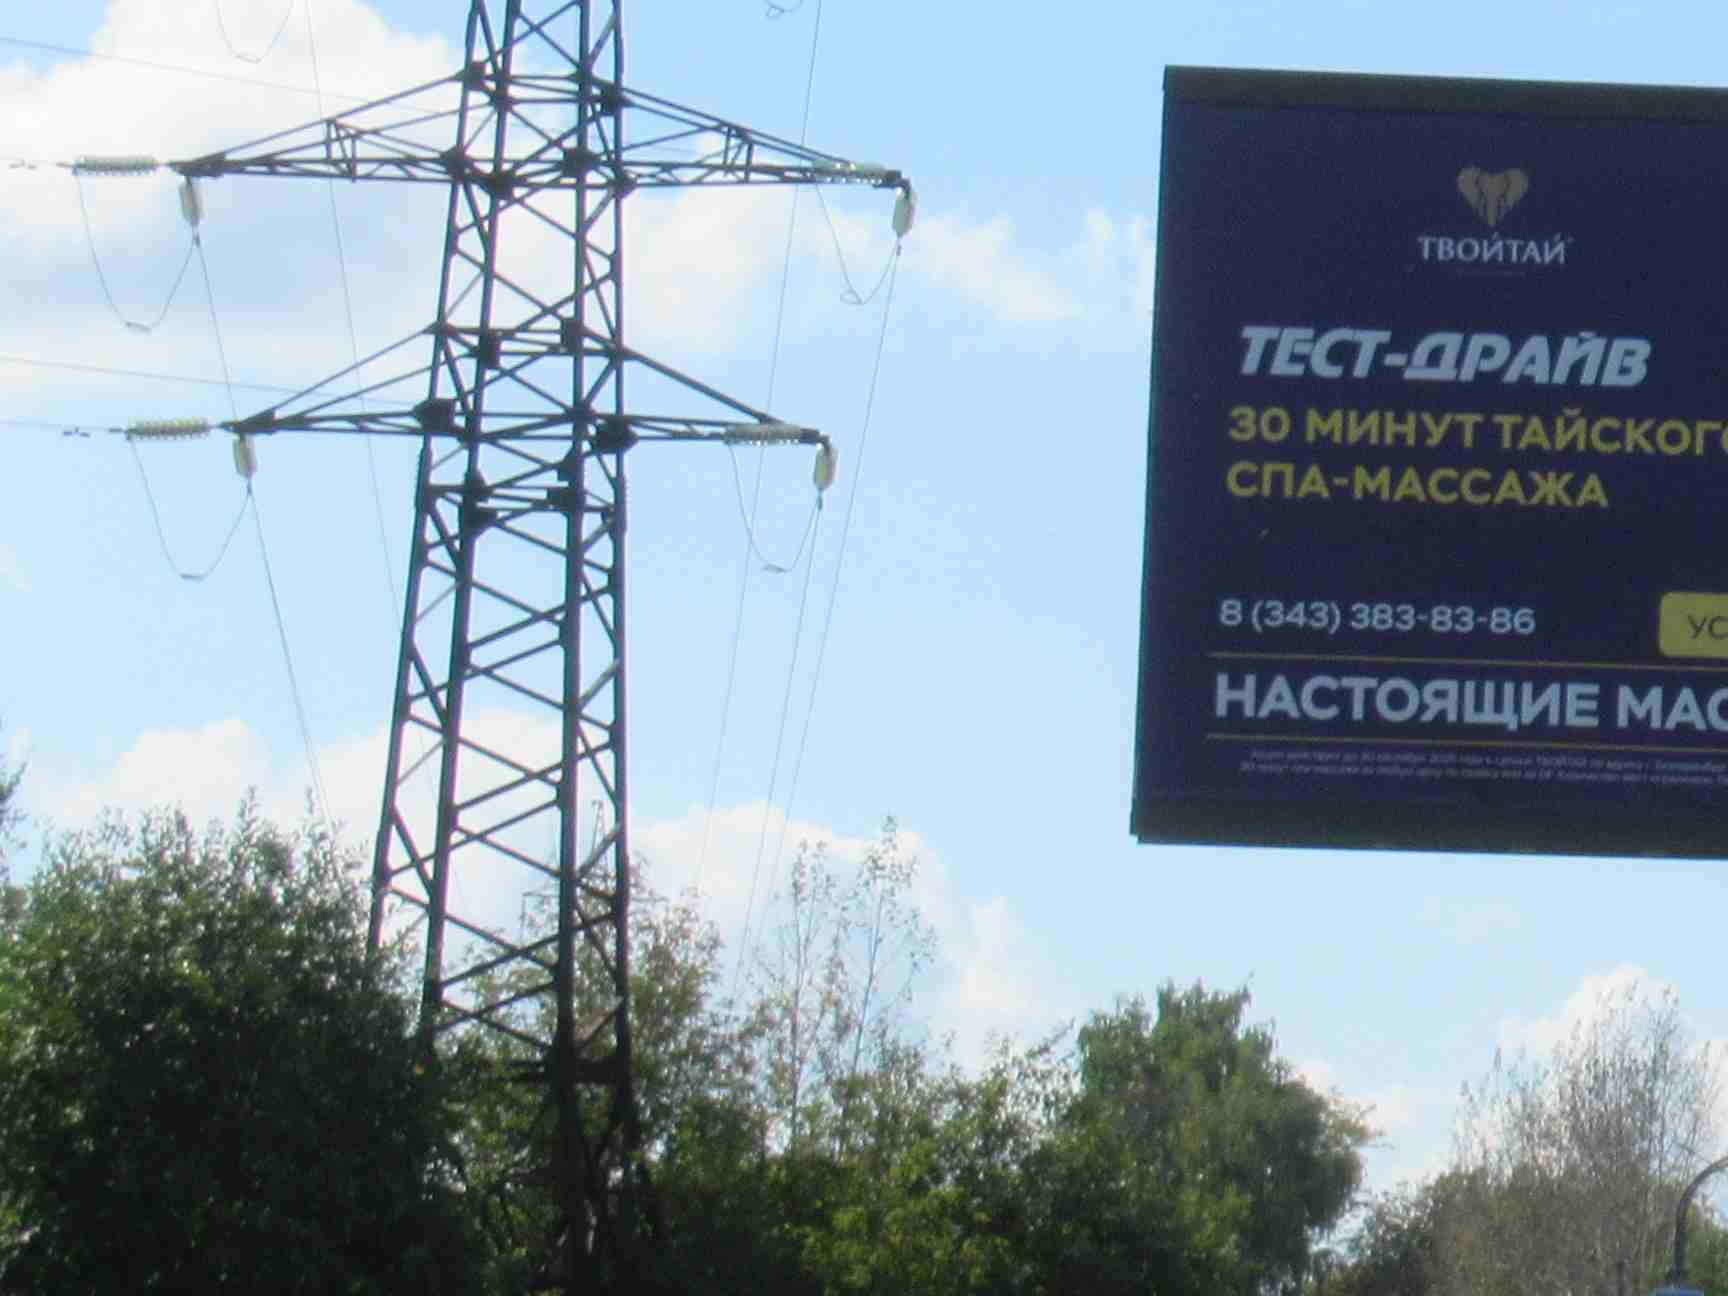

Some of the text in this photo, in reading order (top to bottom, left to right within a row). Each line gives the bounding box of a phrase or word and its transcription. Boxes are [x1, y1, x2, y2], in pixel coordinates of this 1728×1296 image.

[1416, 231, 1566, 264] ТВОЙТАЙ
[1240, 325, 1651, 387] ТЕСТ-ДРАЙВ
[1228, 406, 1291, 444] 30
[1305, 407, 1484, 448] МИНУТ
[1226, 460, 1609, 508] СПА-МАССАЖА
[1219, 599, 1537, 635] 8 (343) 383-83-86
[1215, 673, 1600, 731] НАСТОЯЩИЕ
